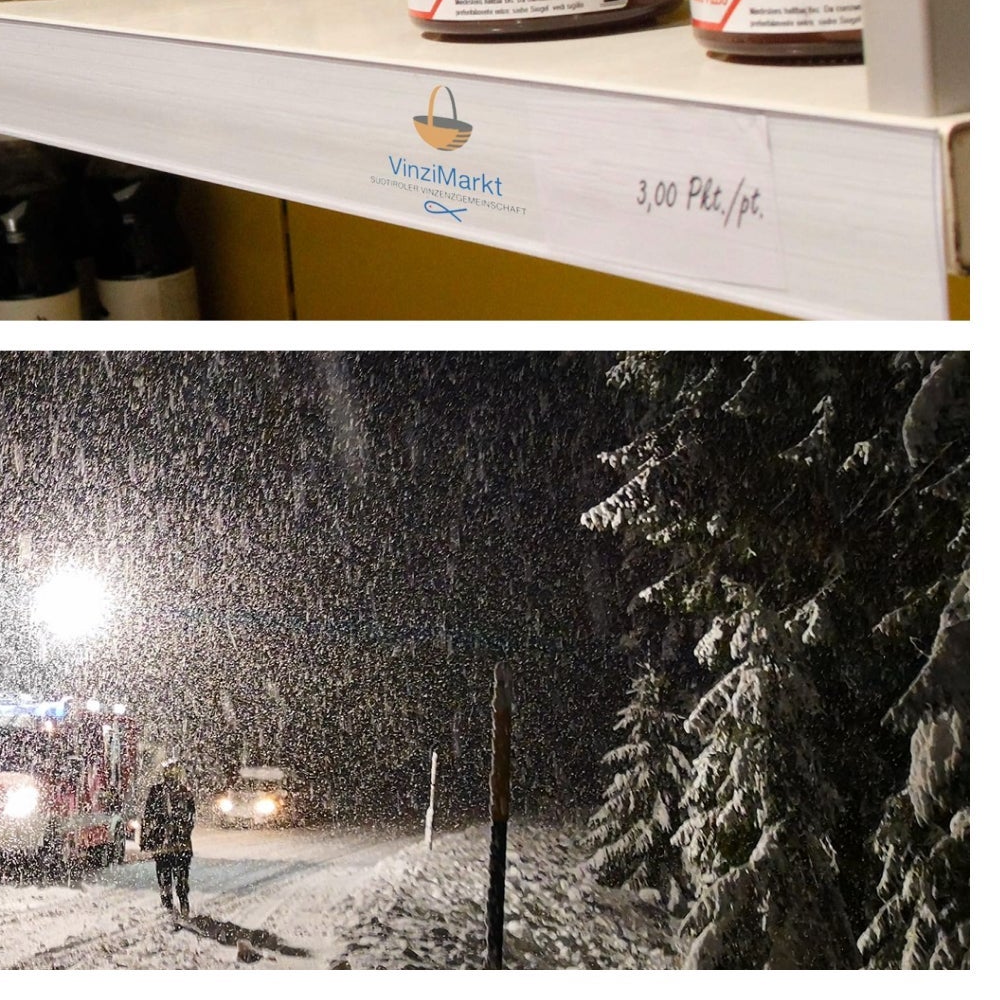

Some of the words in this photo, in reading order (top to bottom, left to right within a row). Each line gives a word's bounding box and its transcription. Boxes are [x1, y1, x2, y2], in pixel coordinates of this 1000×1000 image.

[388, 155, 503, 197] VinziMarkt
[420, 186, 527, 215] VINZENZGEMEINSCHAFT
[636, 180, 677, 213] 3,00
[686, 176, 764, 229] Pkt./pt.
